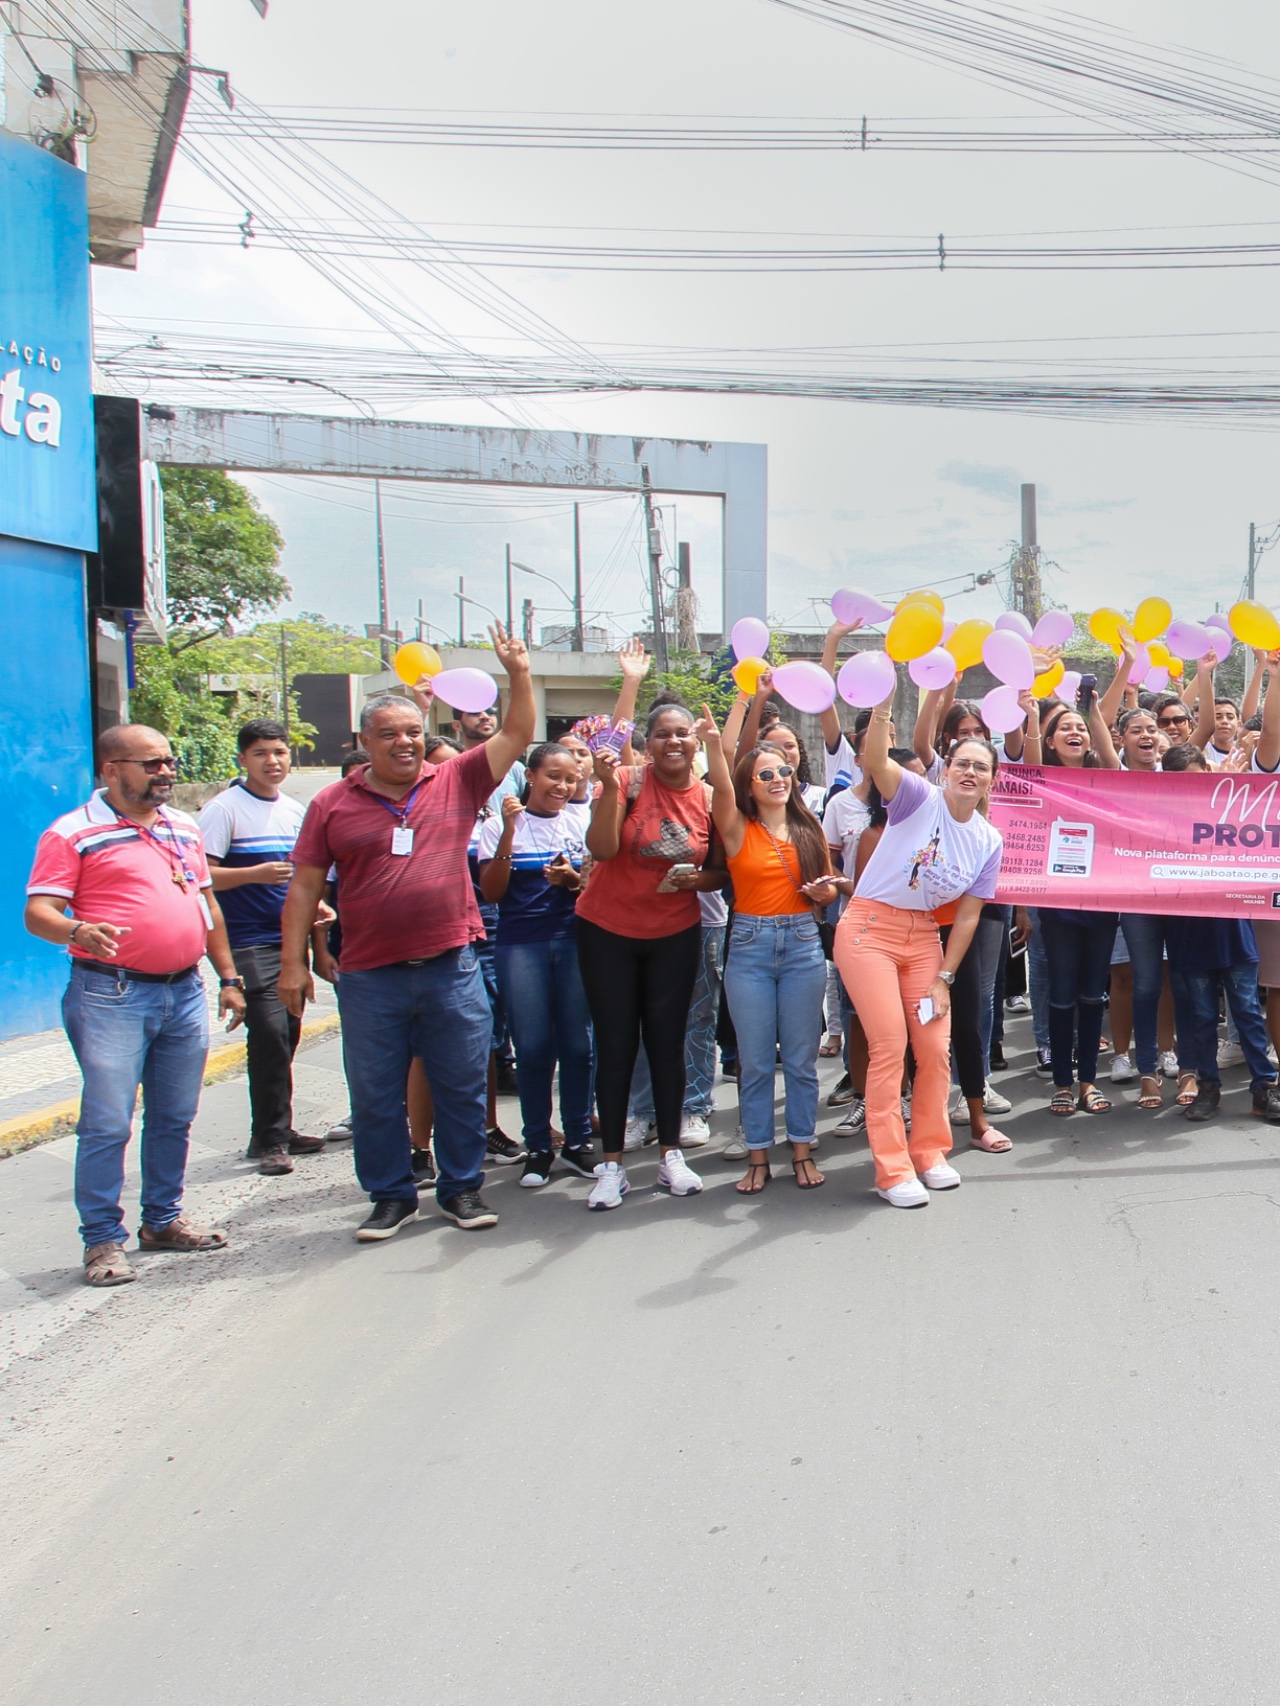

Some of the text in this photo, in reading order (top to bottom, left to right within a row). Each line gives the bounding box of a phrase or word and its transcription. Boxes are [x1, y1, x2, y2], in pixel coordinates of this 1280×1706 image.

[1114, 847, 1142, 858] Nova
[1144, 849, 1208, 861] plataforma
[1210, 854, 1235, 863] para
